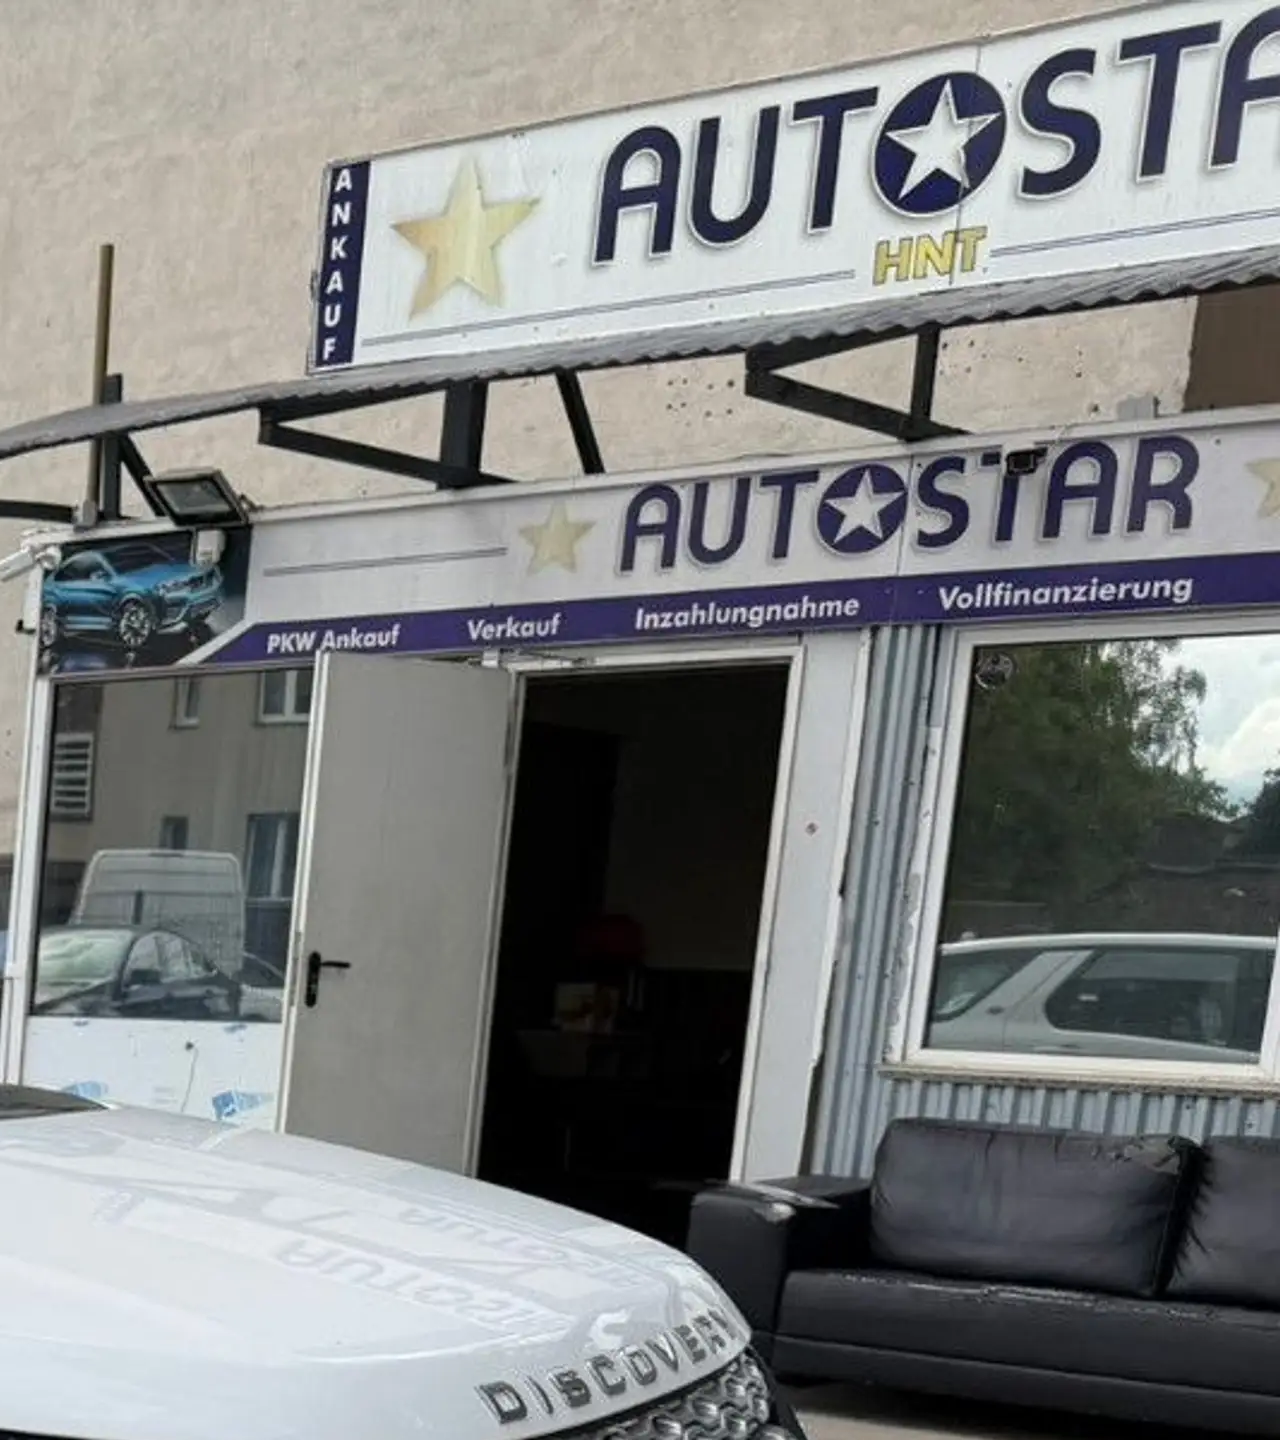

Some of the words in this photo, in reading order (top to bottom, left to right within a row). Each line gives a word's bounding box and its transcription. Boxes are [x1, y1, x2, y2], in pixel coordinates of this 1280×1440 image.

[322, 168, 352, 361] ANKAUF
[872, 225, 989, 287] HNT
[621, 435, 1200, 571] AUTOSTAR
[267, 631, 317, 653] PKW
[320, 623, 401, 650] Ankauf
[467, 612, 562, 641] Verkauf
[636, 595, 860, 630] Inzahlungnahme
[939, 576, 1193, 612] Vollfinanzierung
[475, 1307, 738, 1425] DISCOVERY
